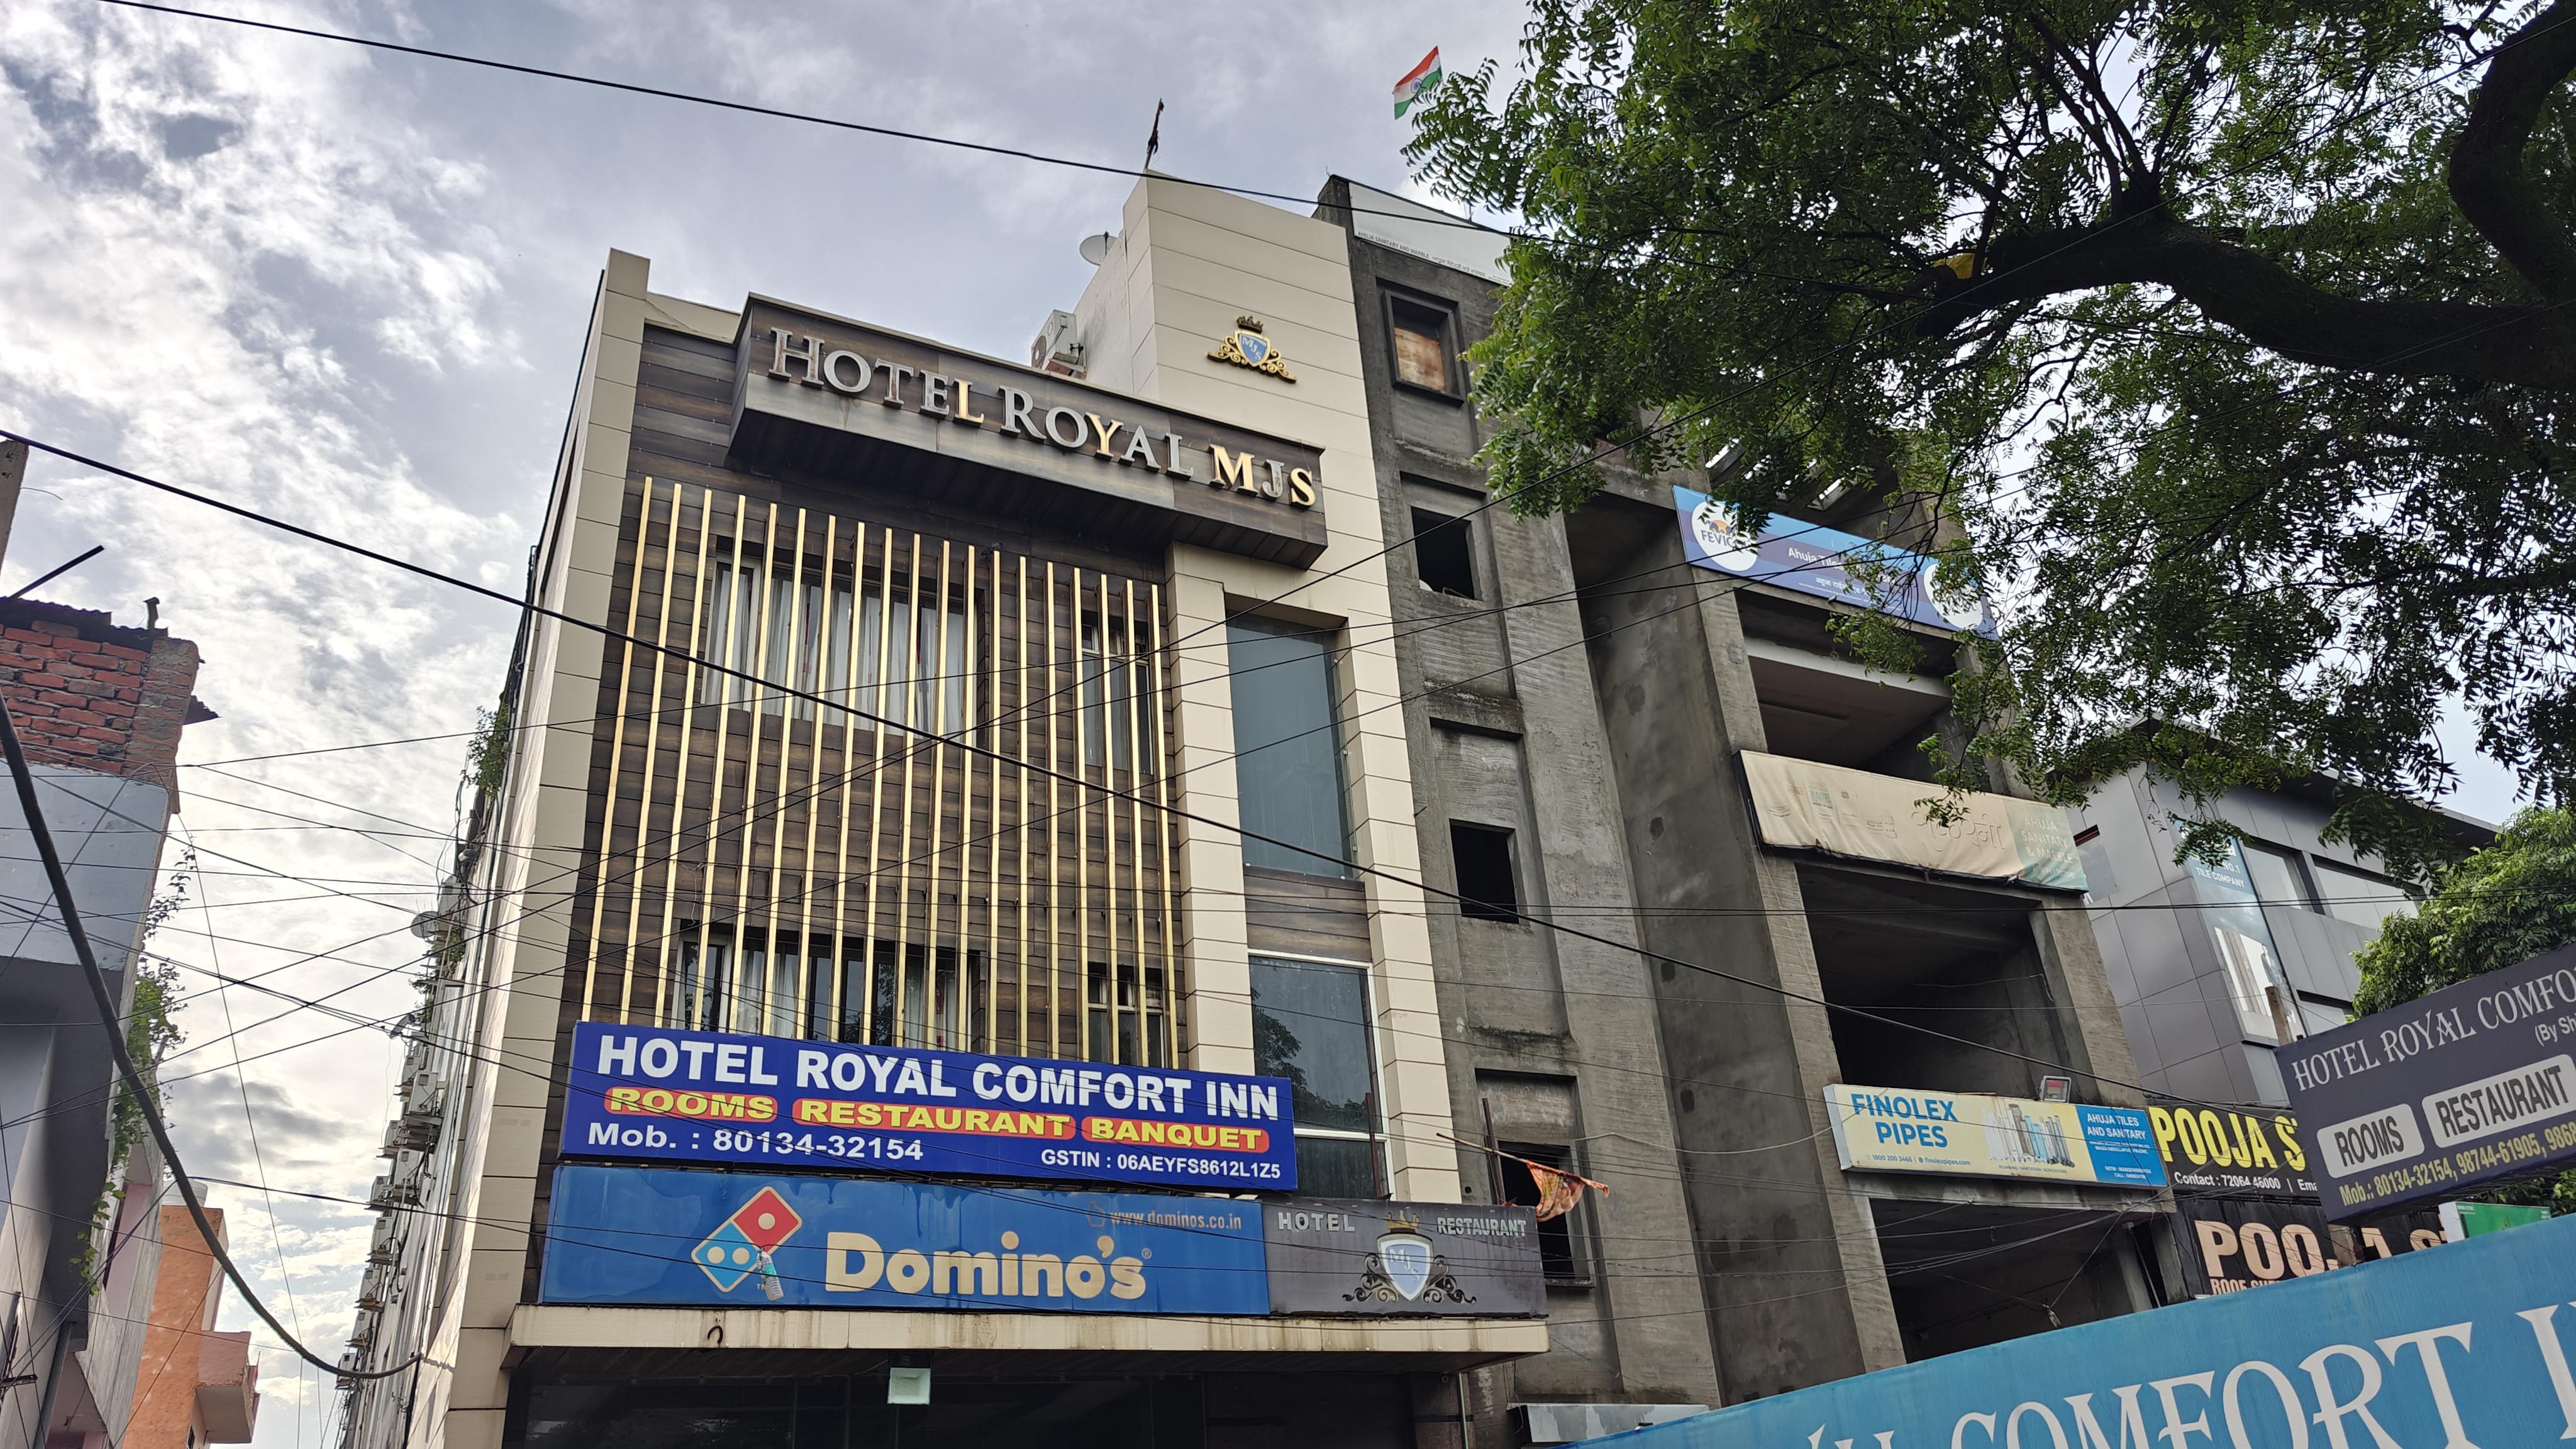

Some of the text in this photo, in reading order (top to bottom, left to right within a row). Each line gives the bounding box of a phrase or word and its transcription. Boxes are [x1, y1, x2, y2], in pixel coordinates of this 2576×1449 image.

[768, 327, 1317, 508] HOTEL ROYAL MJS
[1789, 547, 1817, 565] Ahuja
[2024, 817, 2058, 831] AHUJA
[2021, 830, 2068, 848] SANITARY
[2036, 847, 2074, 863] MARBLE
[2195, 867, 2245, 888] TILE COMPANY
[2290, 966, 2576, 1092] HOTEL ROYAL COMFO
[2534, 1013, 2576, 1047] (By Sh
[597, 1035, 1279, 1121] HOTEL ROYAL COMFORT INN
[609, 1087, 1262, 1150] ROOMS RESTAURANT BANQUET
[1850, 1093, 1958, 1122] FINOLEX
[2087, 1113, 2140, 1126] AHUJA TILES
[2334, 1065, 2570, 1167] ROOMS RESTAURANT
[587, 1122, 677, 1149] Mob.
[713, 1129, 924, 1162] 80134-32154
[1875, 1122, 1948, 1148] PIPES
[2088, 1126, 2146, 1140] AND SANITARY
[2148, 1107, 2306, 1172] POOJA S
[1041, 1148, 1101, 1169] GSTIN
[1116, 1153, 1282, 1180] 06AEYFS8612L1Z5
[2174, 1172, 2216, 1186] Contact
[2221, 1175, 2251, 1187] 72064
[1111, 1209, 1241, 1230] www.dominos.co.in
[1277, 1211, 1527, 1238] HOTEL RESTAURANT
[2195, 1219, 2392, 1280] POO
[825, 1230, 1147, 1300] Domino's
